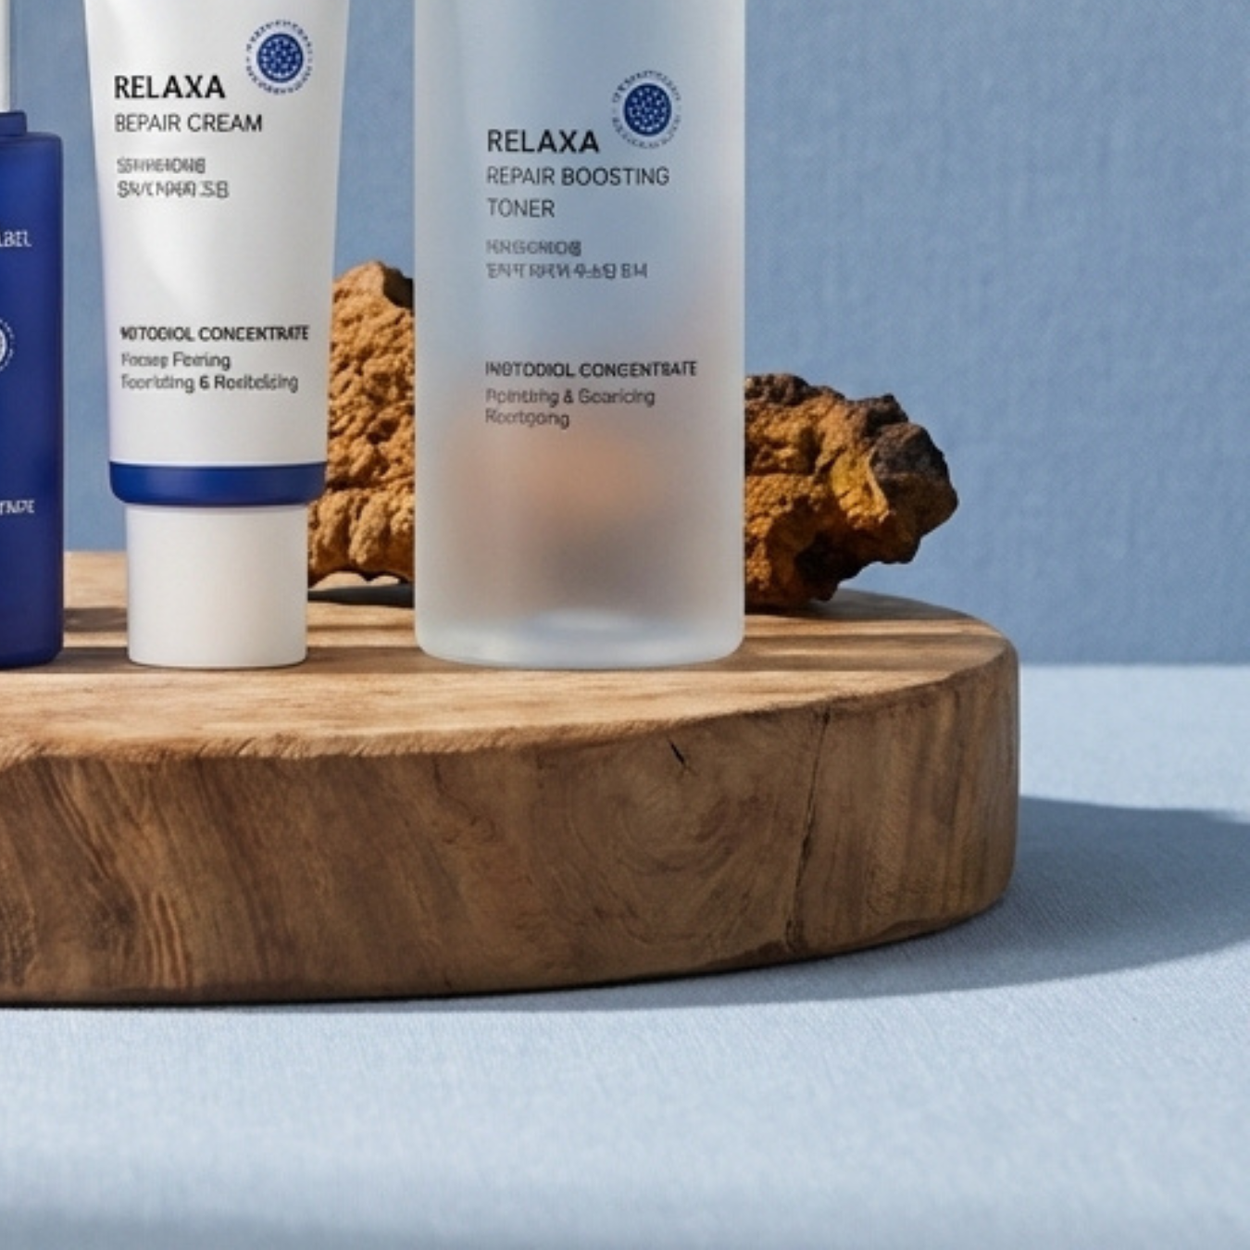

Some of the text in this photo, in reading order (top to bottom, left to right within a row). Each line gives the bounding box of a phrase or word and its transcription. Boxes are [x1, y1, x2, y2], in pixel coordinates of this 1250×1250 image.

[114, 75, 225, 99] RELAXA
[187, 113, 263, 132] CREAM
[487, 129, 600, 153] RELAXA
[486, 166, 670, 186] REPAIR BOOSTING
[487, 199, 555, 218] TONER
